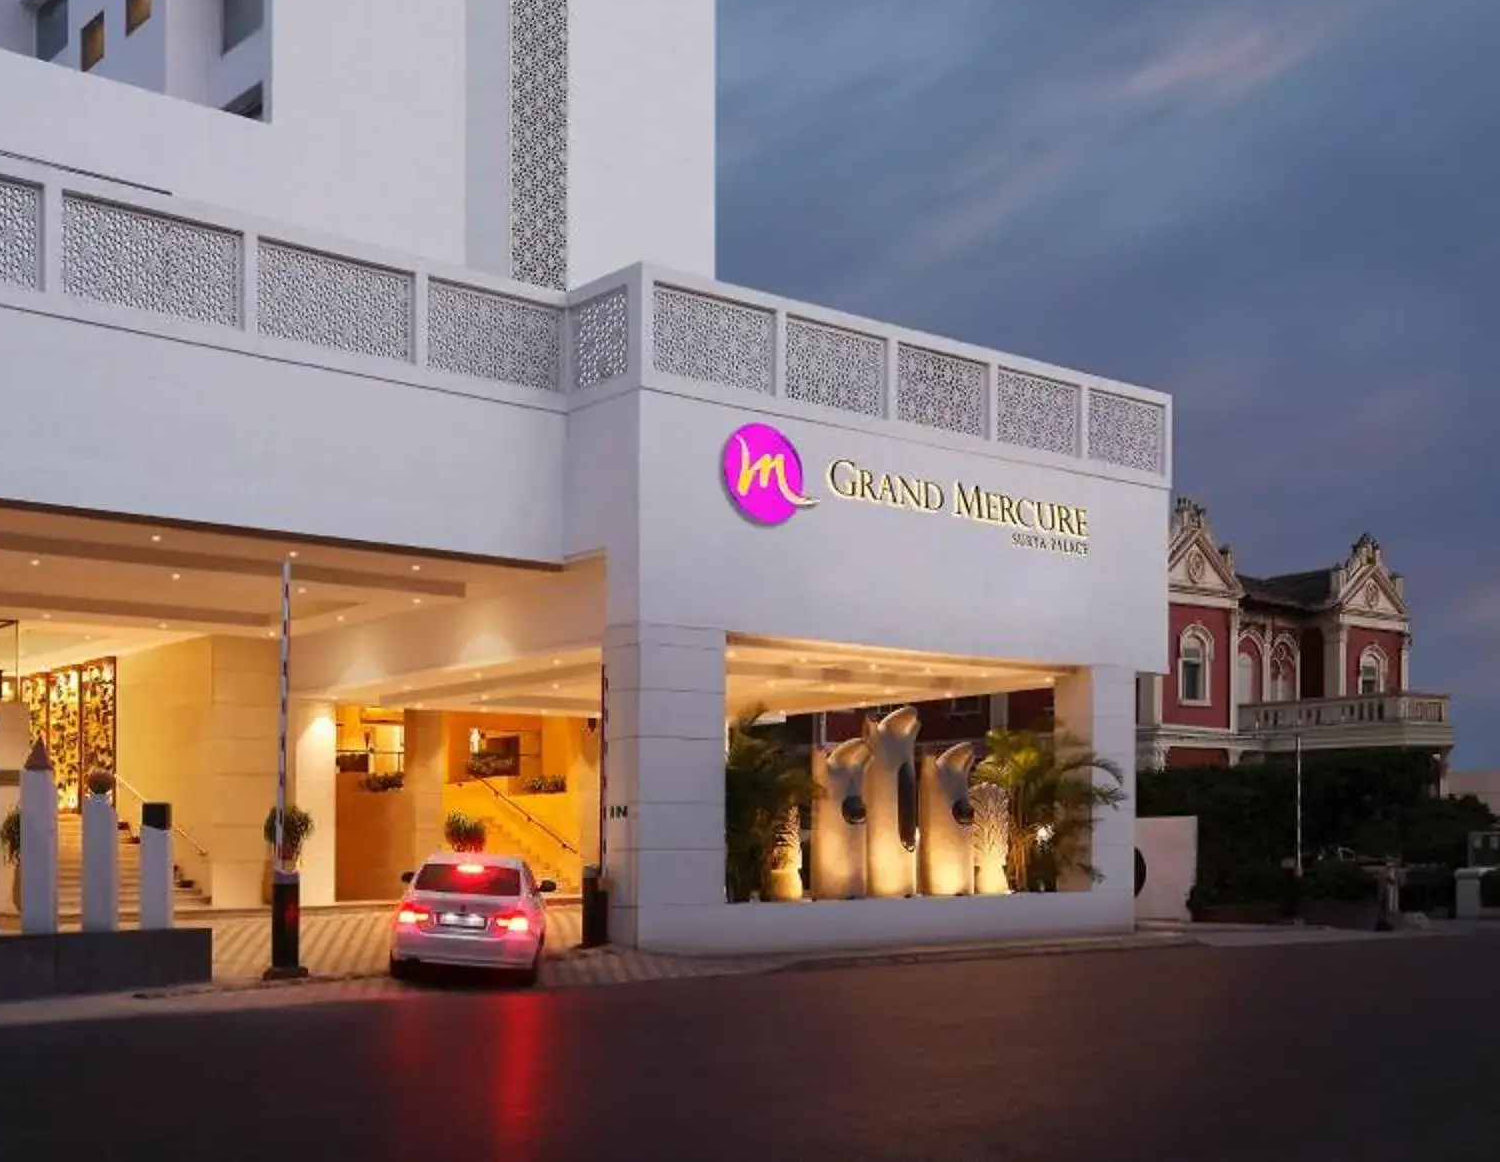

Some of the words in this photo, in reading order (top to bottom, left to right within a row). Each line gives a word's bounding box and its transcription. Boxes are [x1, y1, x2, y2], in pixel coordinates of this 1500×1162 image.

[828, 458, 946, 513] GRAND
[953, 478, 1090, 539] MERCURE
[610, 805, 629, 819] IN
